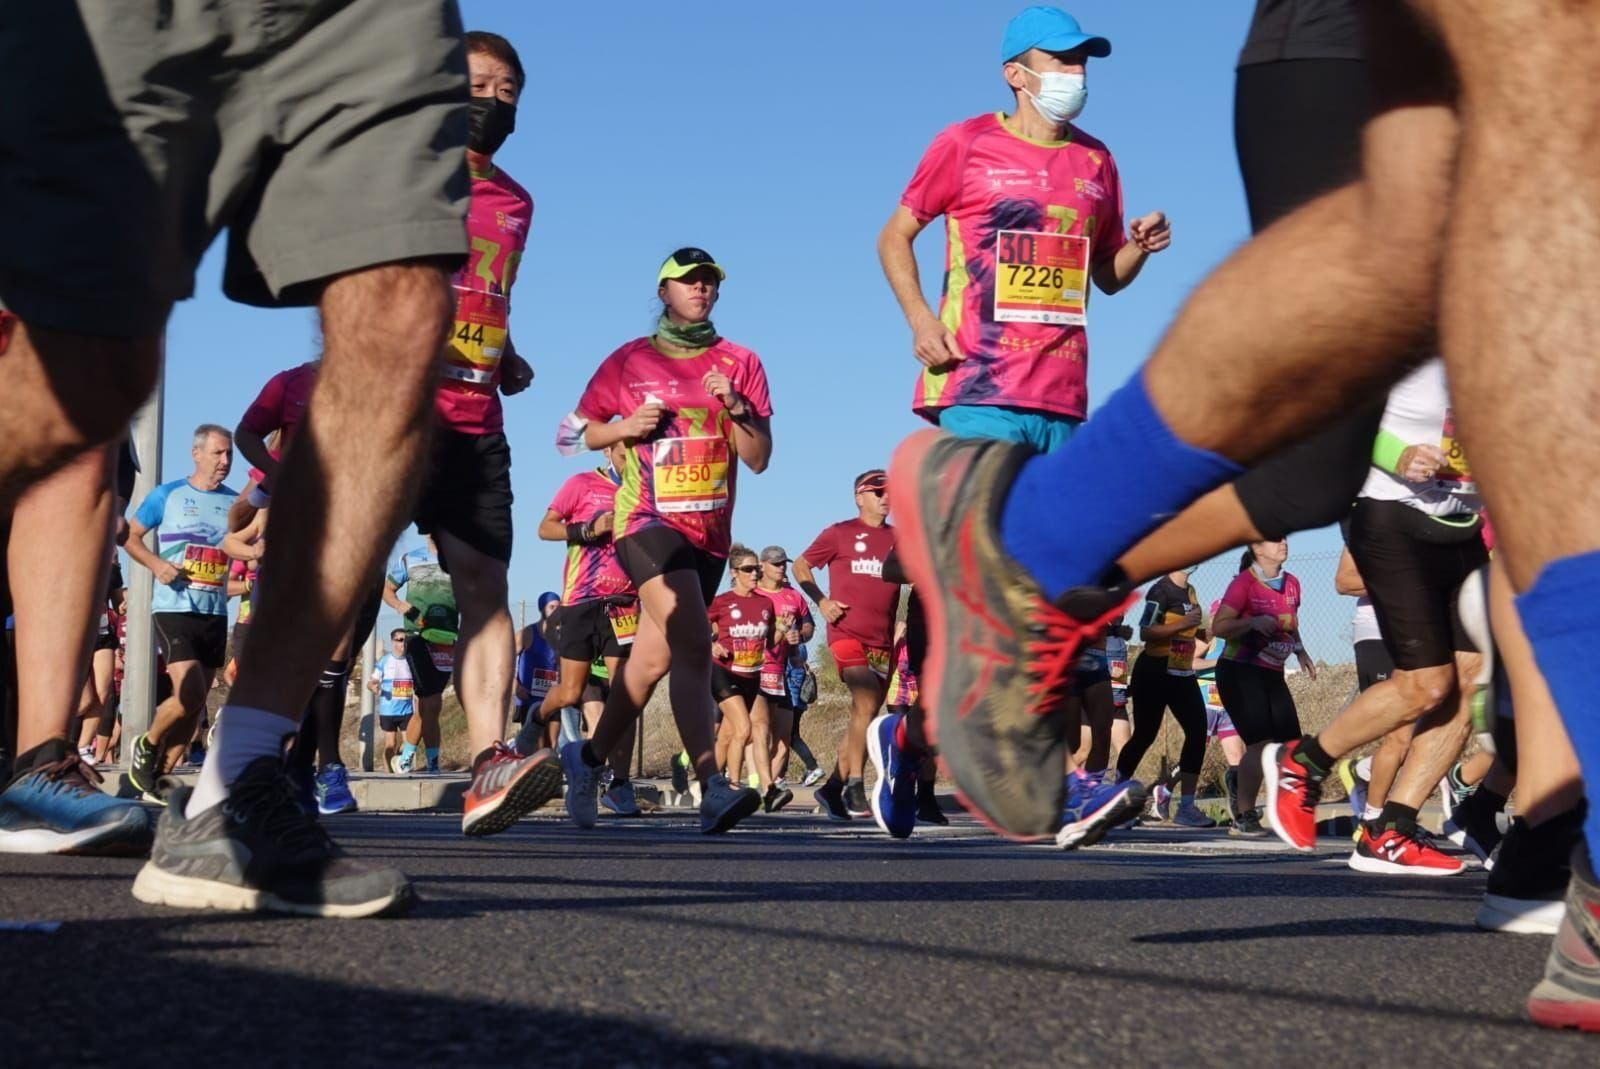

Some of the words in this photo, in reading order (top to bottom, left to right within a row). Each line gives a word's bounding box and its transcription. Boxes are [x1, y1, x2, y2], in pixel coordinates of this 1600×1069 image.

[999, 231, 1035, 264] 30
[1007, 264, 1063, 289] 7226
[661, 464, 711, 484] 7550
[189, 560, 217, 575] 7113
